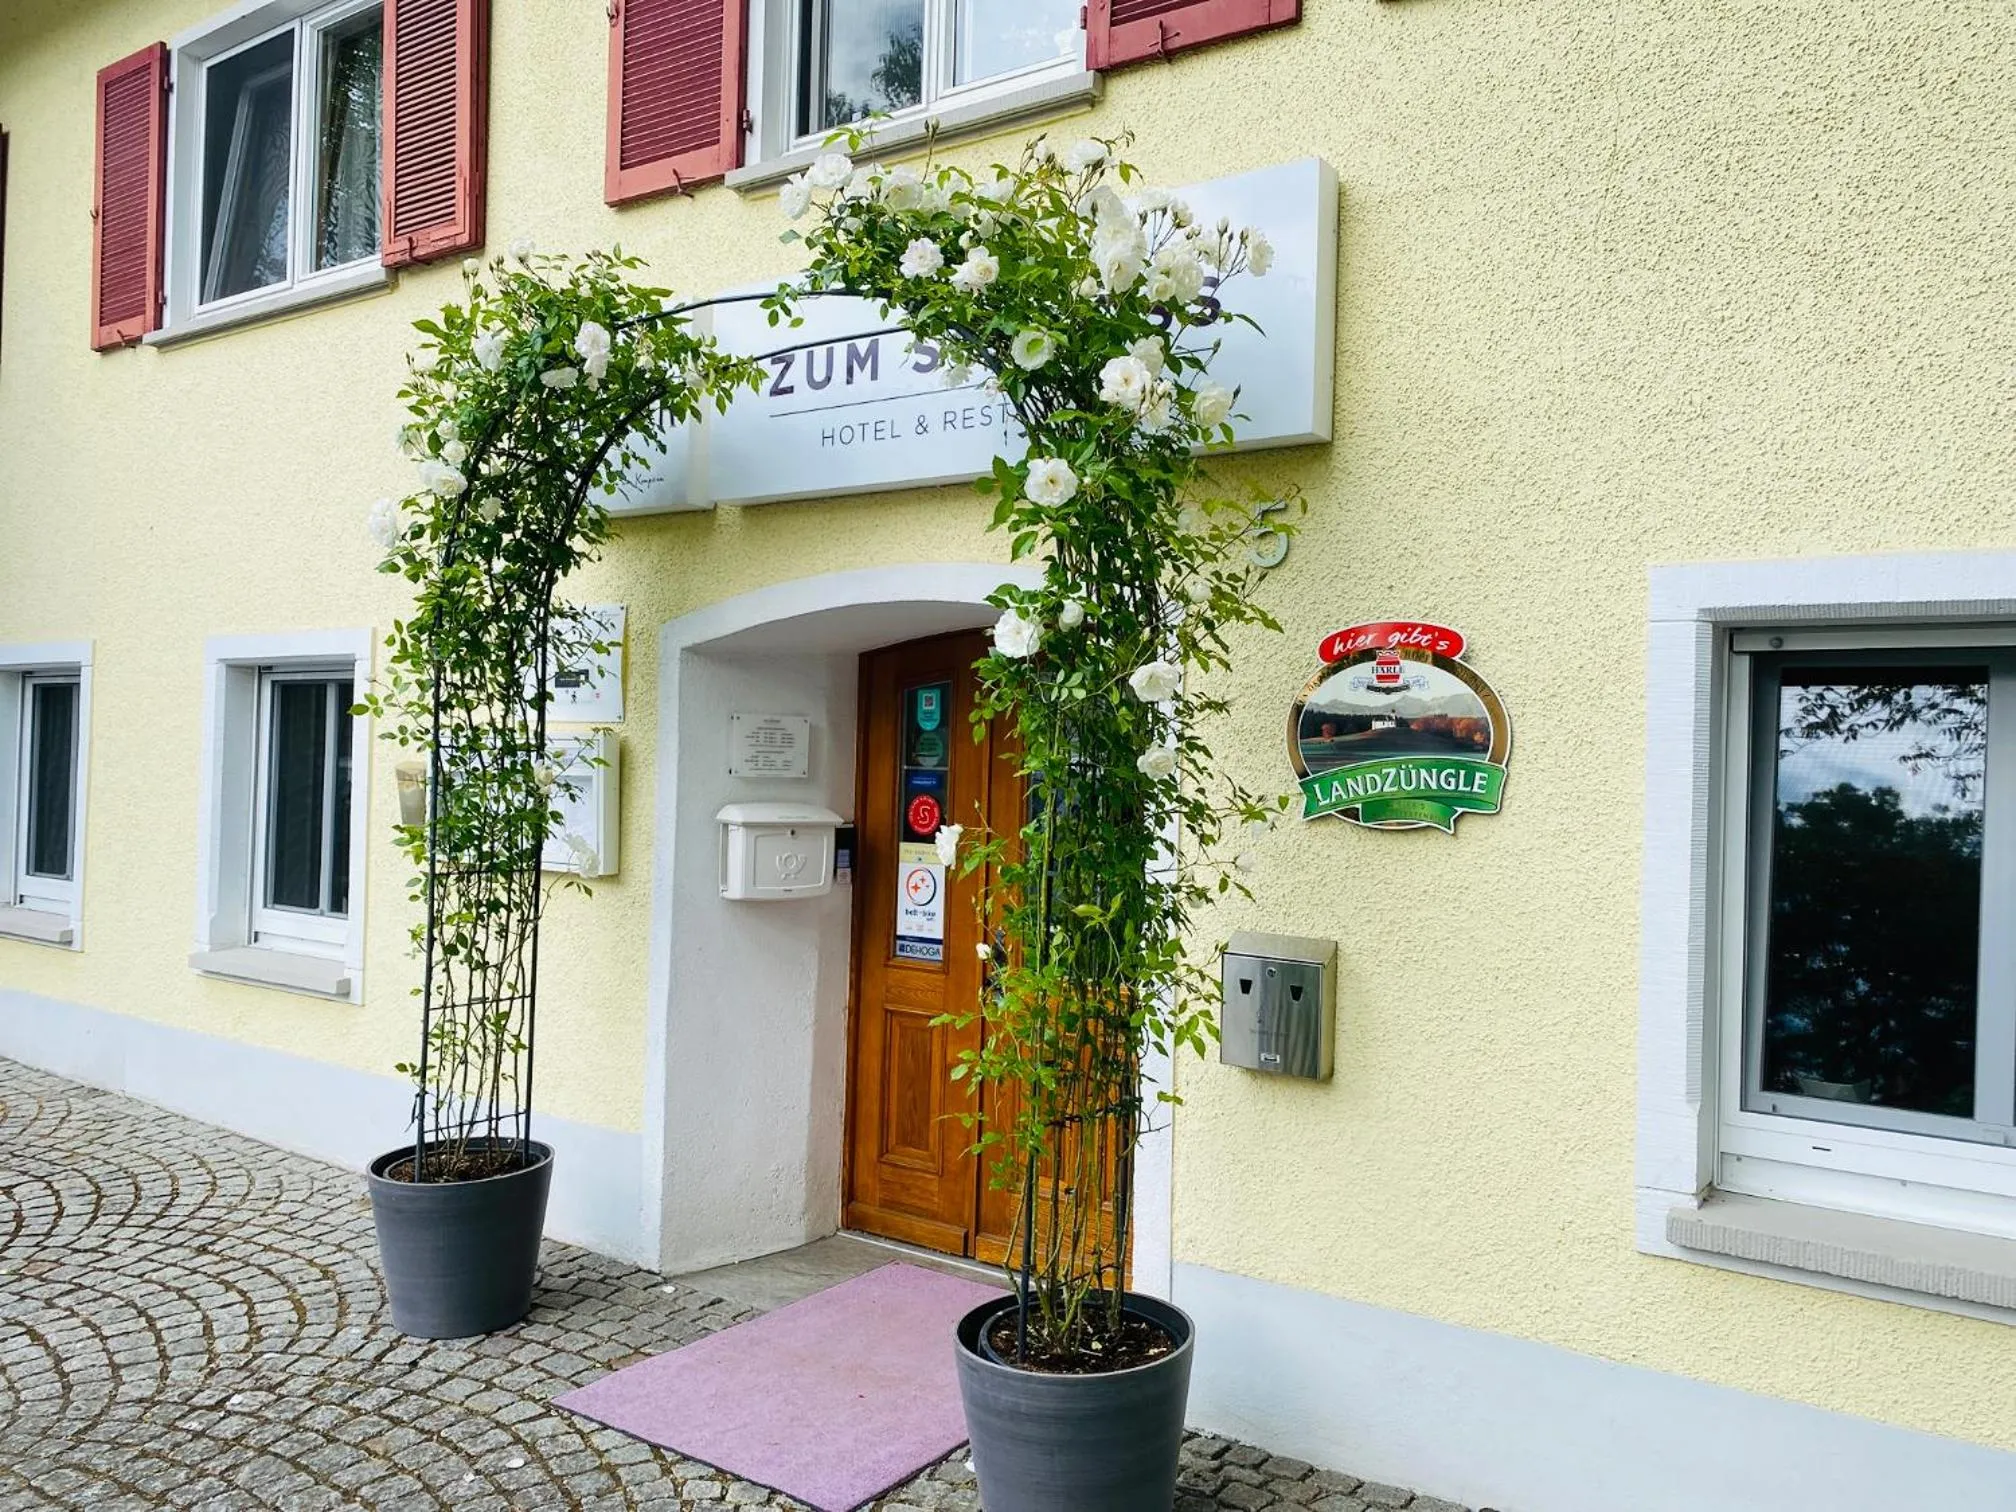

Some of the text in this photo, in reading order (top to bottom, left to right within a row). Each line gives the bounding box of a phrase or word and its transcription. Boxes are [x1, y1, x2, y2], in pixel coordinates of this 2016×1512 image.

[769, 338, 880, 397] ZUM
[821, 402, 1010, 447] HOTEL & REST
[1242, 499, 1288, 568] 5
[1332, 626, 1451, 656] hier gibt's
[1312, 764, 1489, 806] LANDZÜNGLE
